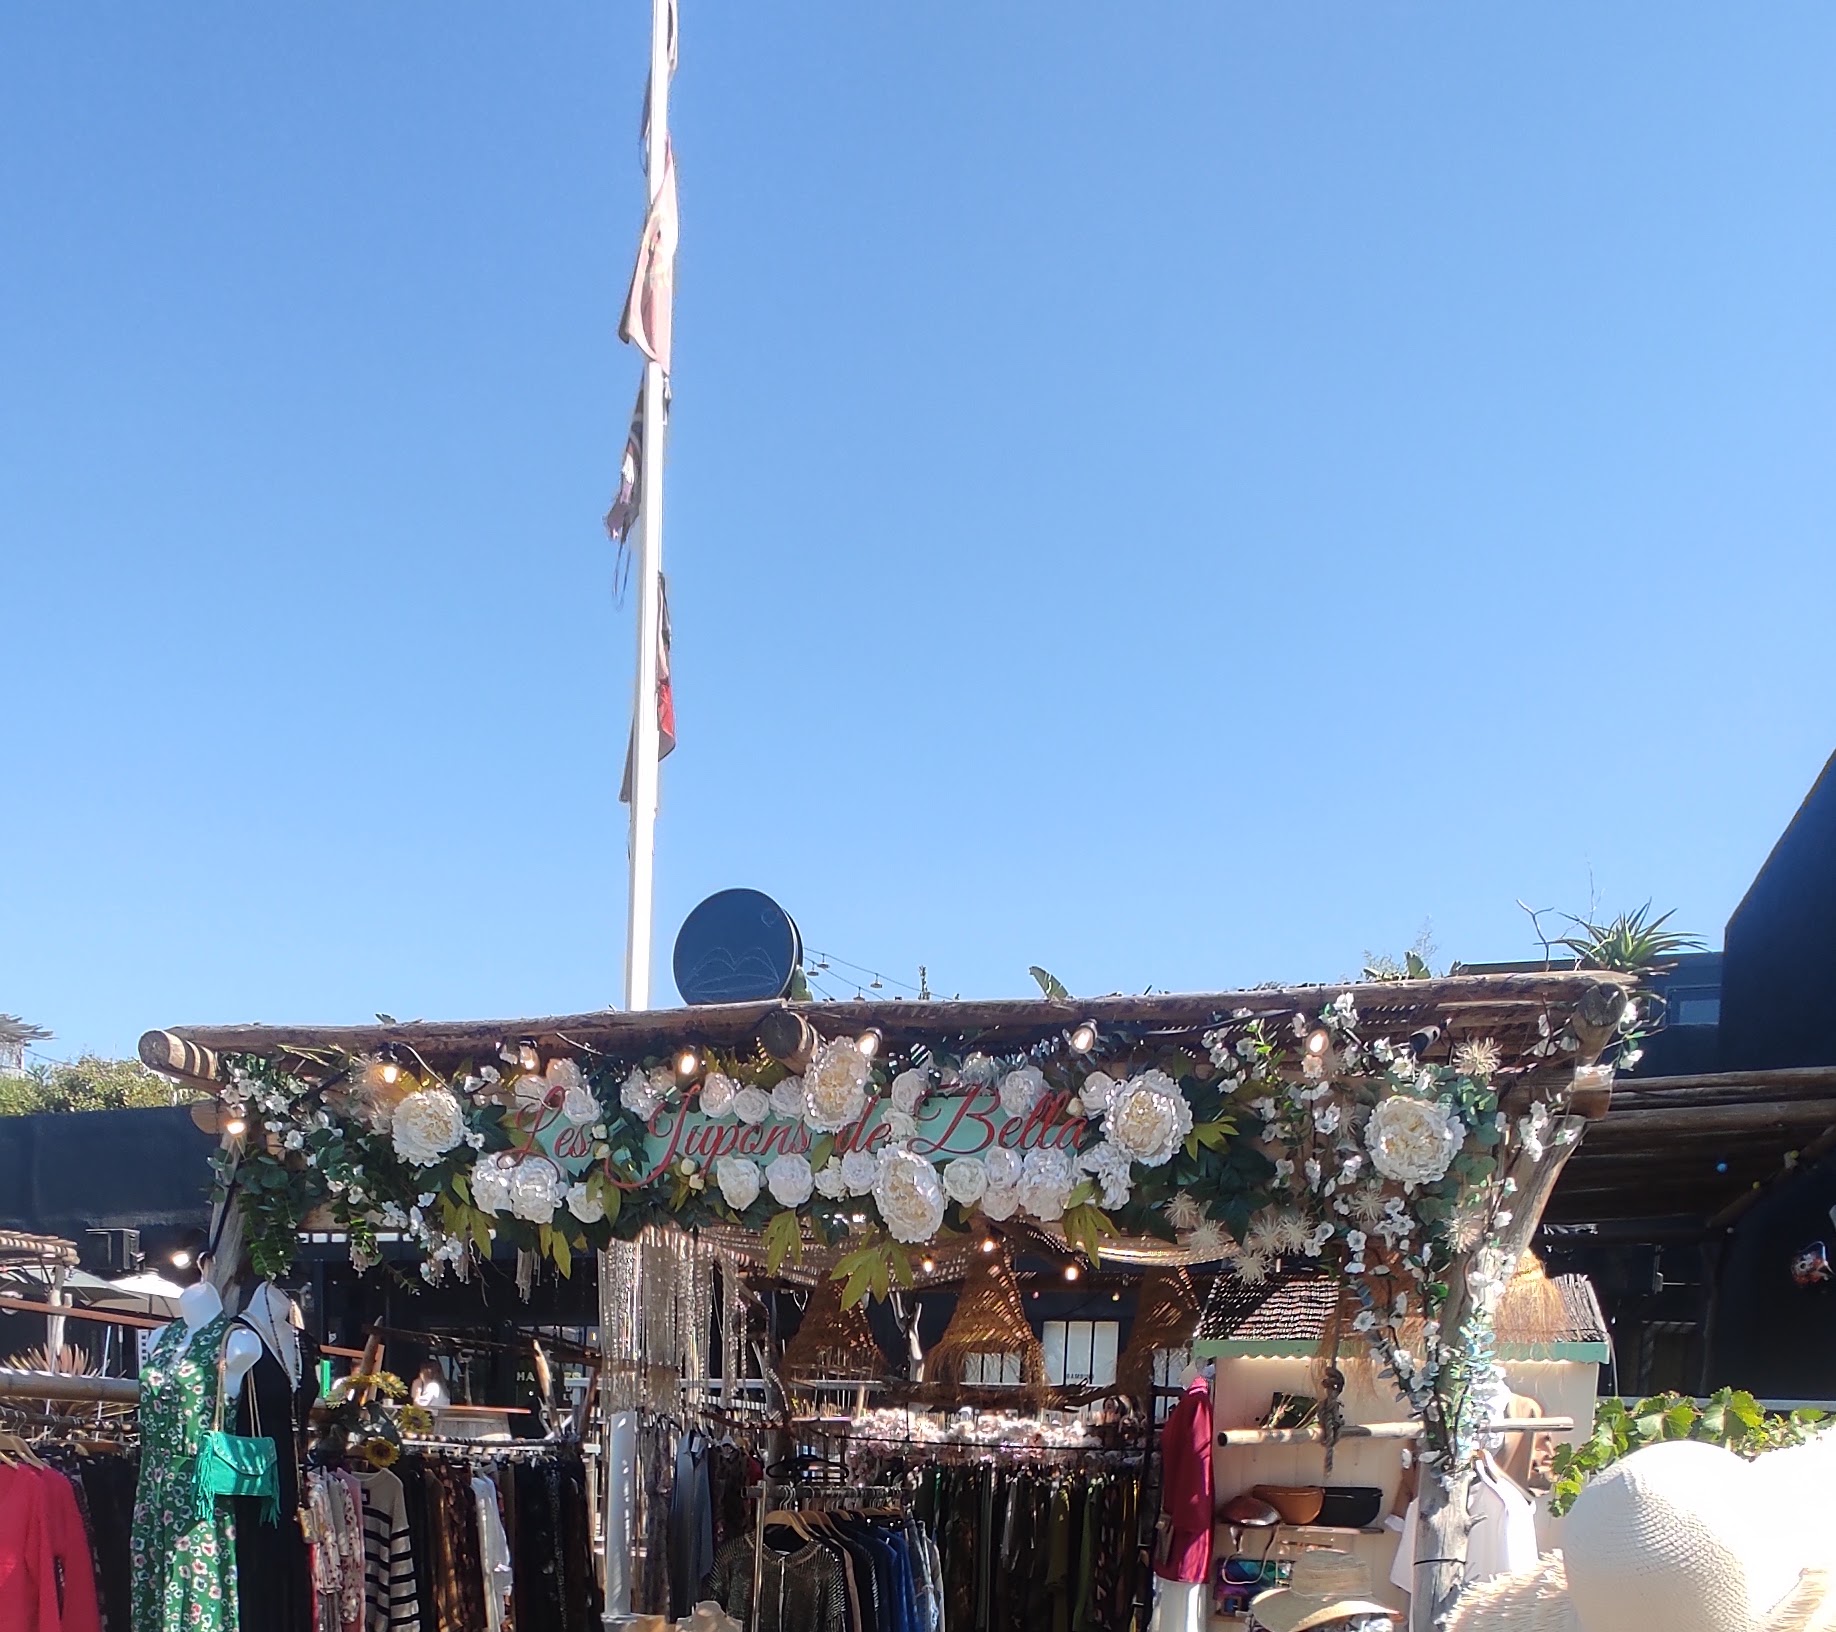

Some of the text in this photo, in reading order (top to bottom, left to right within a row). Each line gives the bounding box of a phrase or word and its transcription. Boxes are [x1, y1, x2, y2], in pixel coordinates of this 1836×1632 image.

[496, 1082, 1089, 1190] Les Jupons de Bella
